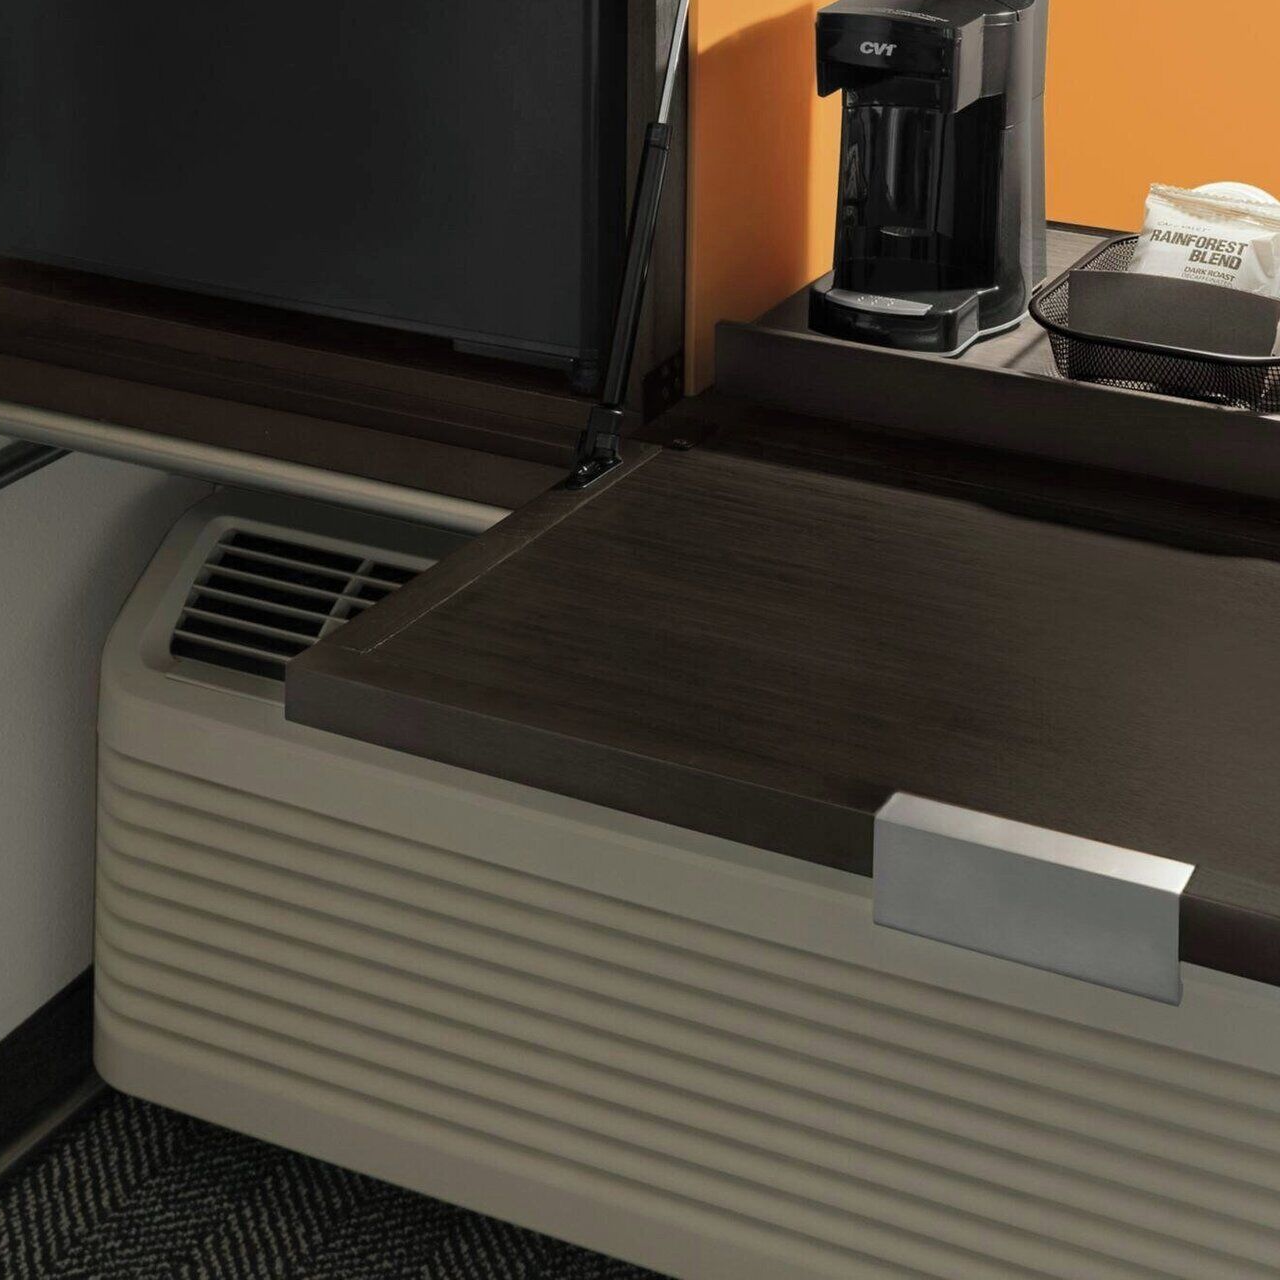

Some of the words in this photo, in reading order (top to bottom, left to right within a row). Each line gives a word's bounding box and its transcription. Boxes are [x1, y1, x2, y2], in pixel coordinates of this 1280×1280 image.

[1150, 229, 1248, 255] RAINFOREST
[1188, 249, 1243, 270] BLEND
[1184, 266, 1207, 276] DARK
[1207, 270, 1236, 282] ROAST
